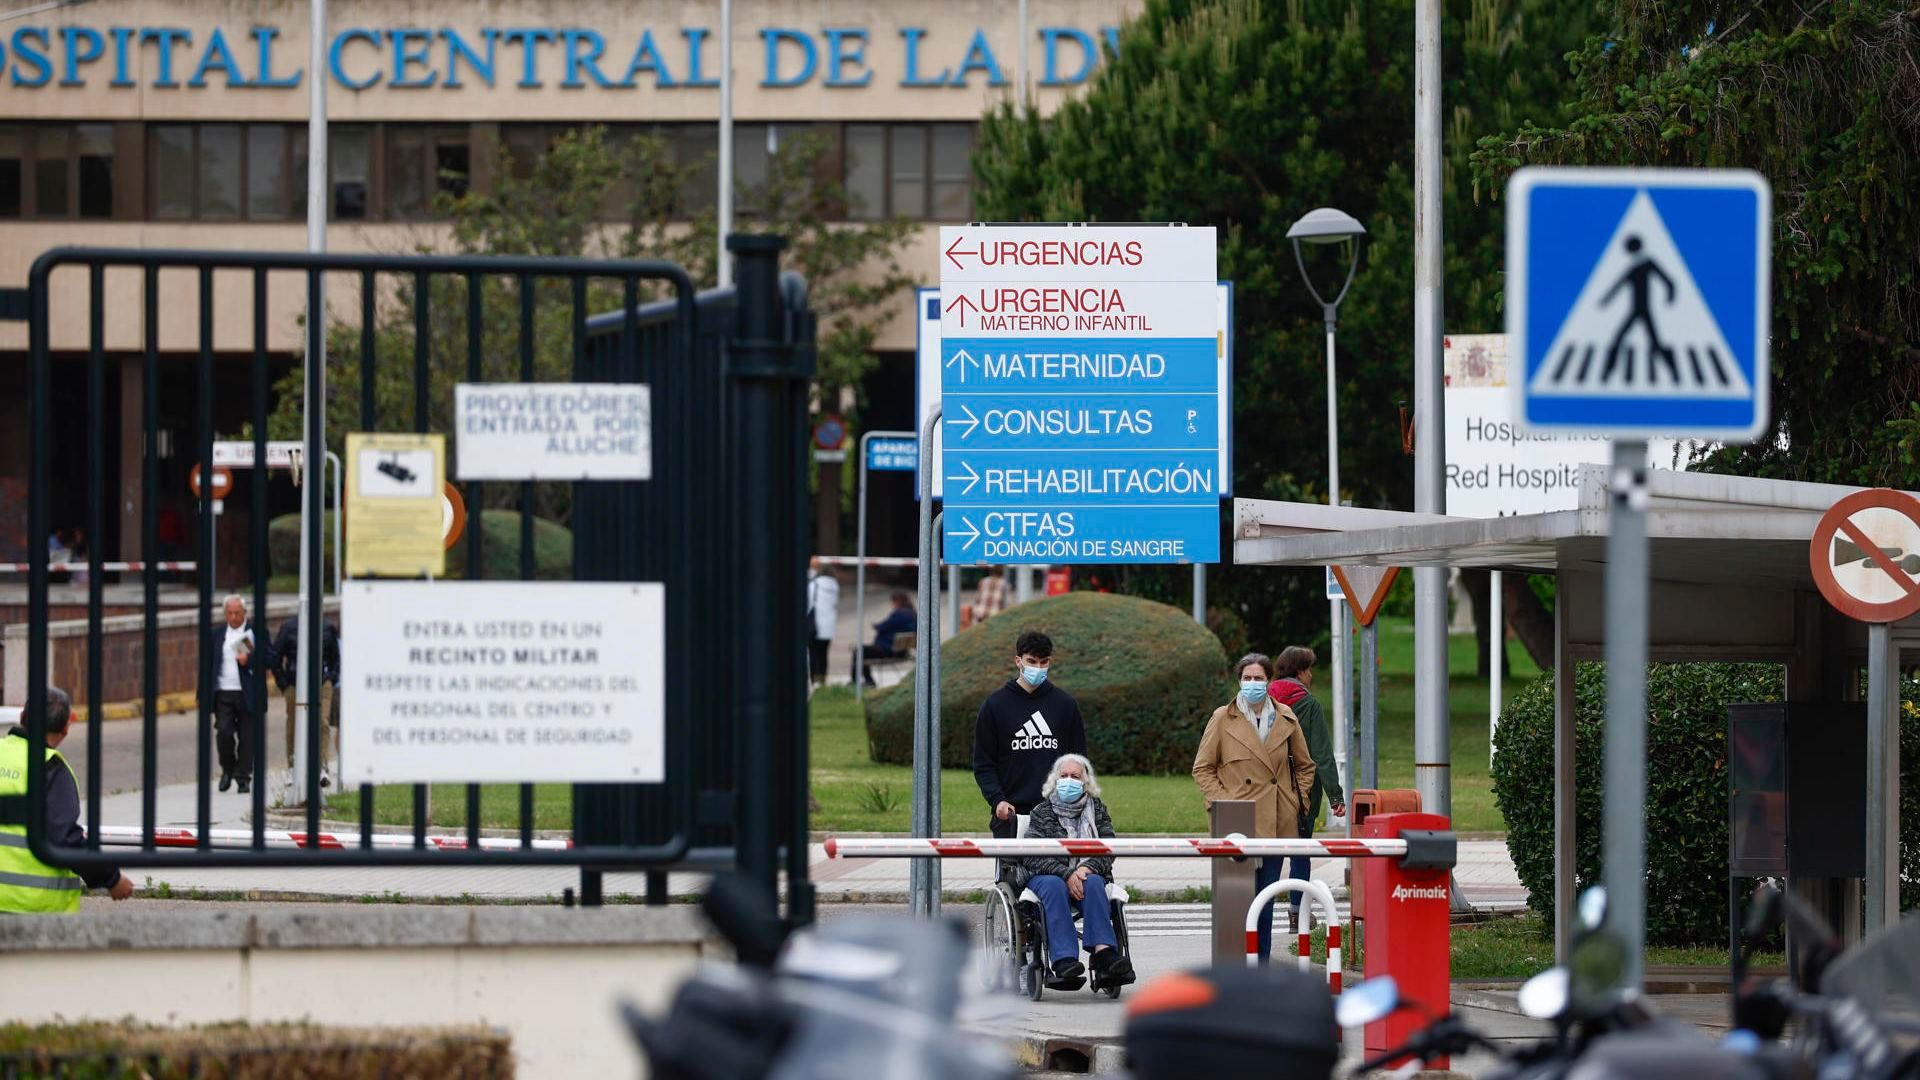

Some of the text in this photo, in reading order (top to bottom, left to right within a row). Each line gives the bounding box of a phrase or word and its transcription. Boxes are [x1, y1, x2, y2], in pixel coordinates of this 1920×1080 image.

[0, 27, 302, 88] SPITAL
[328, 27, 721, 90] CENTRAL
[760, 28, 874, 88] DE
[900, 28, 1011, 88] LA
[980, 241, 1143, 266] URGENCIAS
[980, 288, 1126, 313] URGENCIA
[980, 315, 1153, 331] MATERNO INFANTIL
[984, 353, 1166, 379] MATERNIDAD
[465, 416, 641, 433] ENTRADA POR
[983, 409, 1153, 435] CONSULTAS
[546, 436, 638, 454] ALUCHE
[985, 462, 1211, 494] REHABILITACIÓN
[1446, 464, 1579, 494] Red Hospita
[984, 512, 1075, 537] CTFAS
[984, 537, 1185, 556] DONACIÓN DE SANGRE
[403, 621, 602, 639] ENTRA USTED EN UN
[409, 648, 599, 665] RECINTO MILITAR
[365, 675, 639, 692] RESPETE LAS INDICACIONES DEL
[391, 702, 612, 718] PERSONAL DEL CENTRO Y
[373, 728, 632, 744] DEL PERSONAL DE SEGURIDAD
[1011, 735, 1058, 750] adidas
[1391, 884, 1447, 903] Aprimatic
